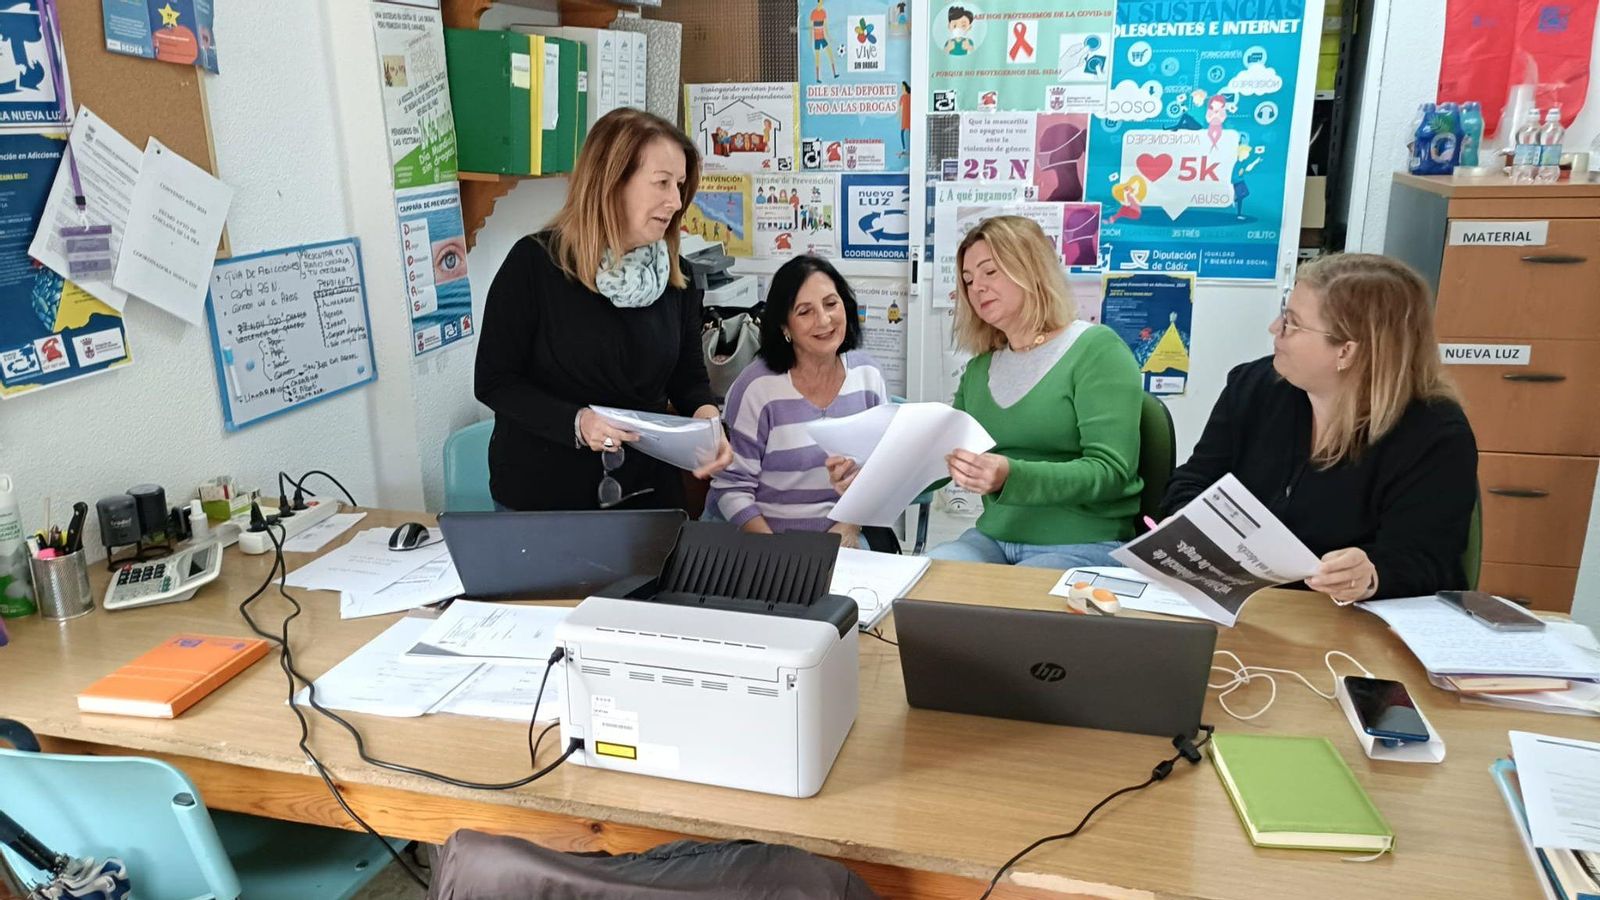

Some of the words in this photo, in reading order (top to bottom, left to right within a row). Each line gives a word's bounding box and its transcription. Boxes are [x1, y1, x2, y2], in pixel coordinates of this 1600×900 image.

[1208, 21, 1220, 35] E
[1222, 18, 1301, 35] INTERNET
[862, 61, 878, 69] DROGAS
[808, 85, 828, 97] DILE
[840, 85, 853, 97] AL
[855, 85, 897, 96] DEPORTE
[807, 102, 816, 113] Y
[816, 102, 829, 113] NO
[832, 102, 839, 112] A
[840, 102, 857, 112] LAS
[858, 101, 897, 112] DROGAS
[12, 110, 44, 121] NUEVA
[979, 128, 1005, 136] apague
[432, 135, 455, 156] Mundial
[1005, 146, 1031, 154] género.
[964, 159, 998, 179] 25
[1008, 159, 1030, 179] N
[1177, 156, 1221, 182] 5k
[781, 177, 789, 185] de
[792, 177, 835, 185] Prevención
[858, 190, 894, 198] nueva
[939, 191, 944, 203] ¿
[947, 190, 953, 201] A
[957, 189, 972, 203] qué
[974, 187, 1018, 203] jugamos?
[1190, 194, 1230, 205] ABUSO
[858, 198, 892, 206] LUZ
[1463, 231, 1532, 243] MATERIAL
[845, 250, 904, 258] COORDINADORA
[1153, 250, 1197, 260] Diputación
[1152, 262, 1162, 270] de
[1165, 261, 1188, 271] Cádiz
[1445, 348, 1491, 359] NUEVA
[1495, 348, 1520, 359] LUZ
[1036, 662, 1063, 682] hp
